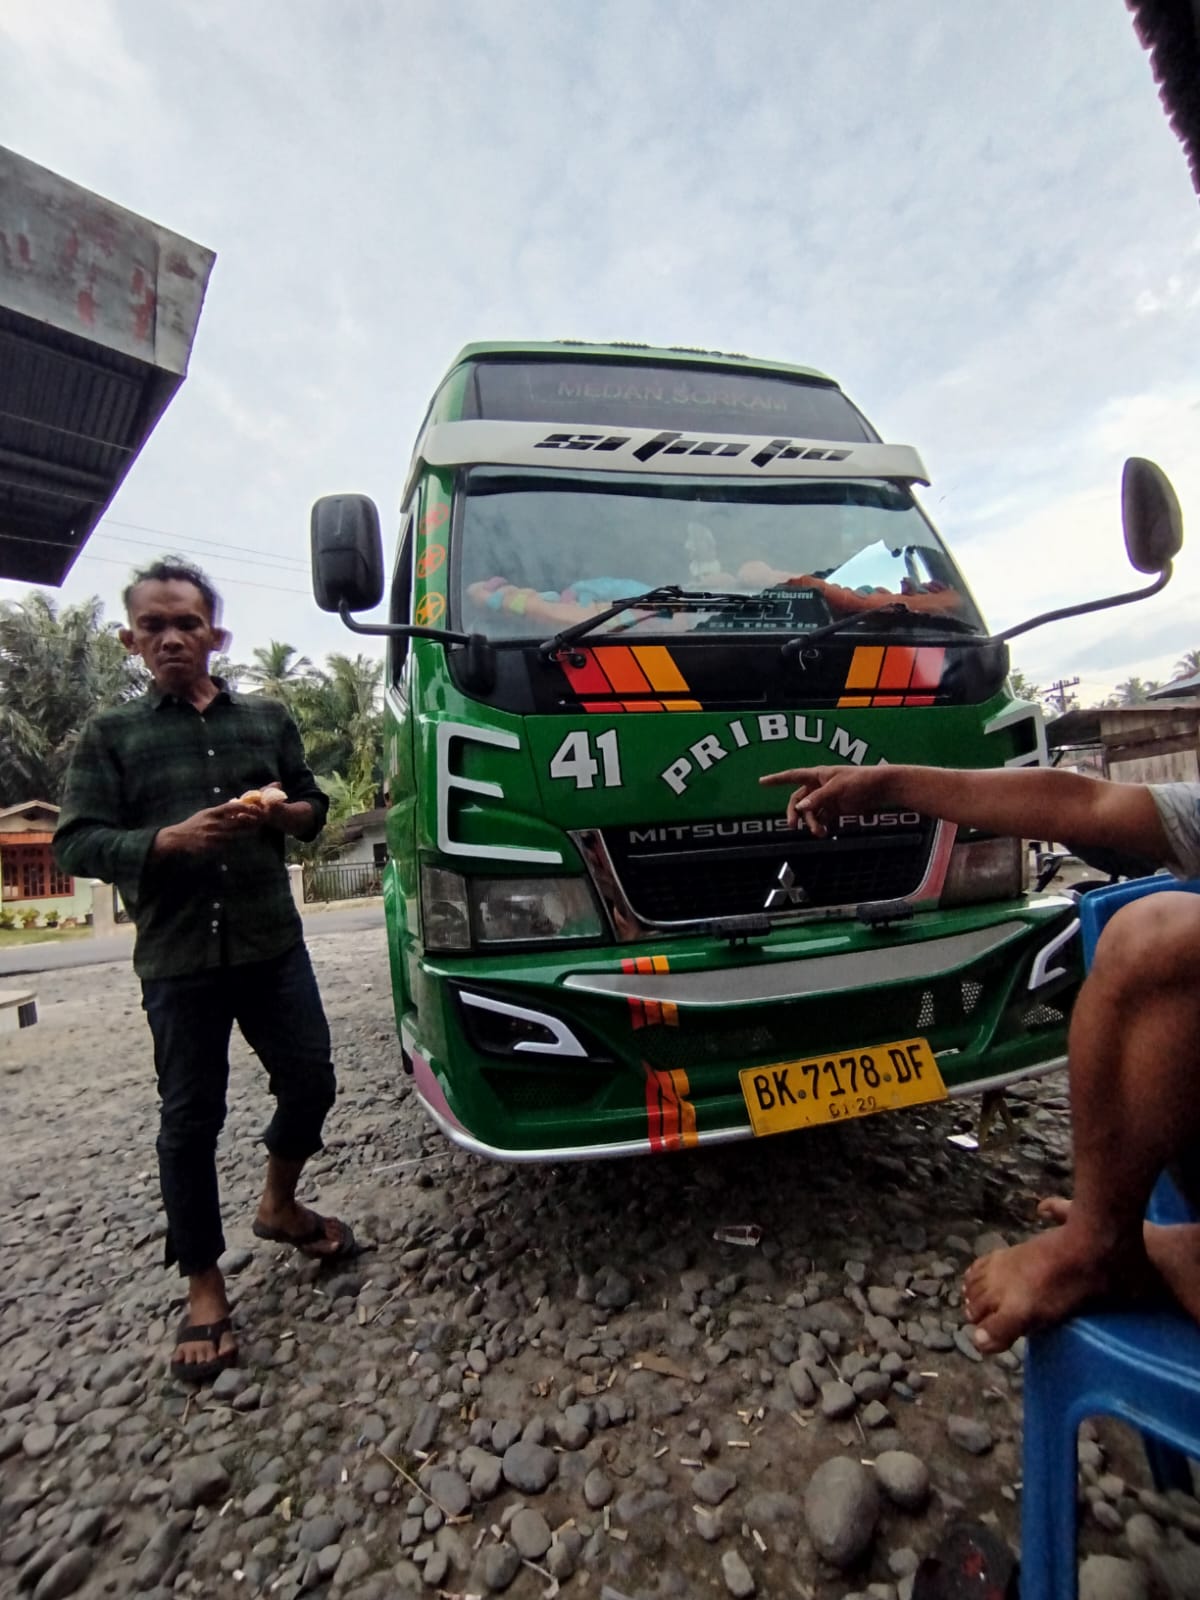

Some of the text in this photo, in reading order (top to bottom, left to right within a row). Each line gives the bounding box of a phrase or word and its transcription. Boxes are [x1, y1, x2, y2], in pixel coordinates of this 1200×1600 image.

[550, 728, 623, 789] 41
[629, 811, 920, 844] MITSUBIS FUSO
[753, 1044, 924, 1111] BK 7178 DF
